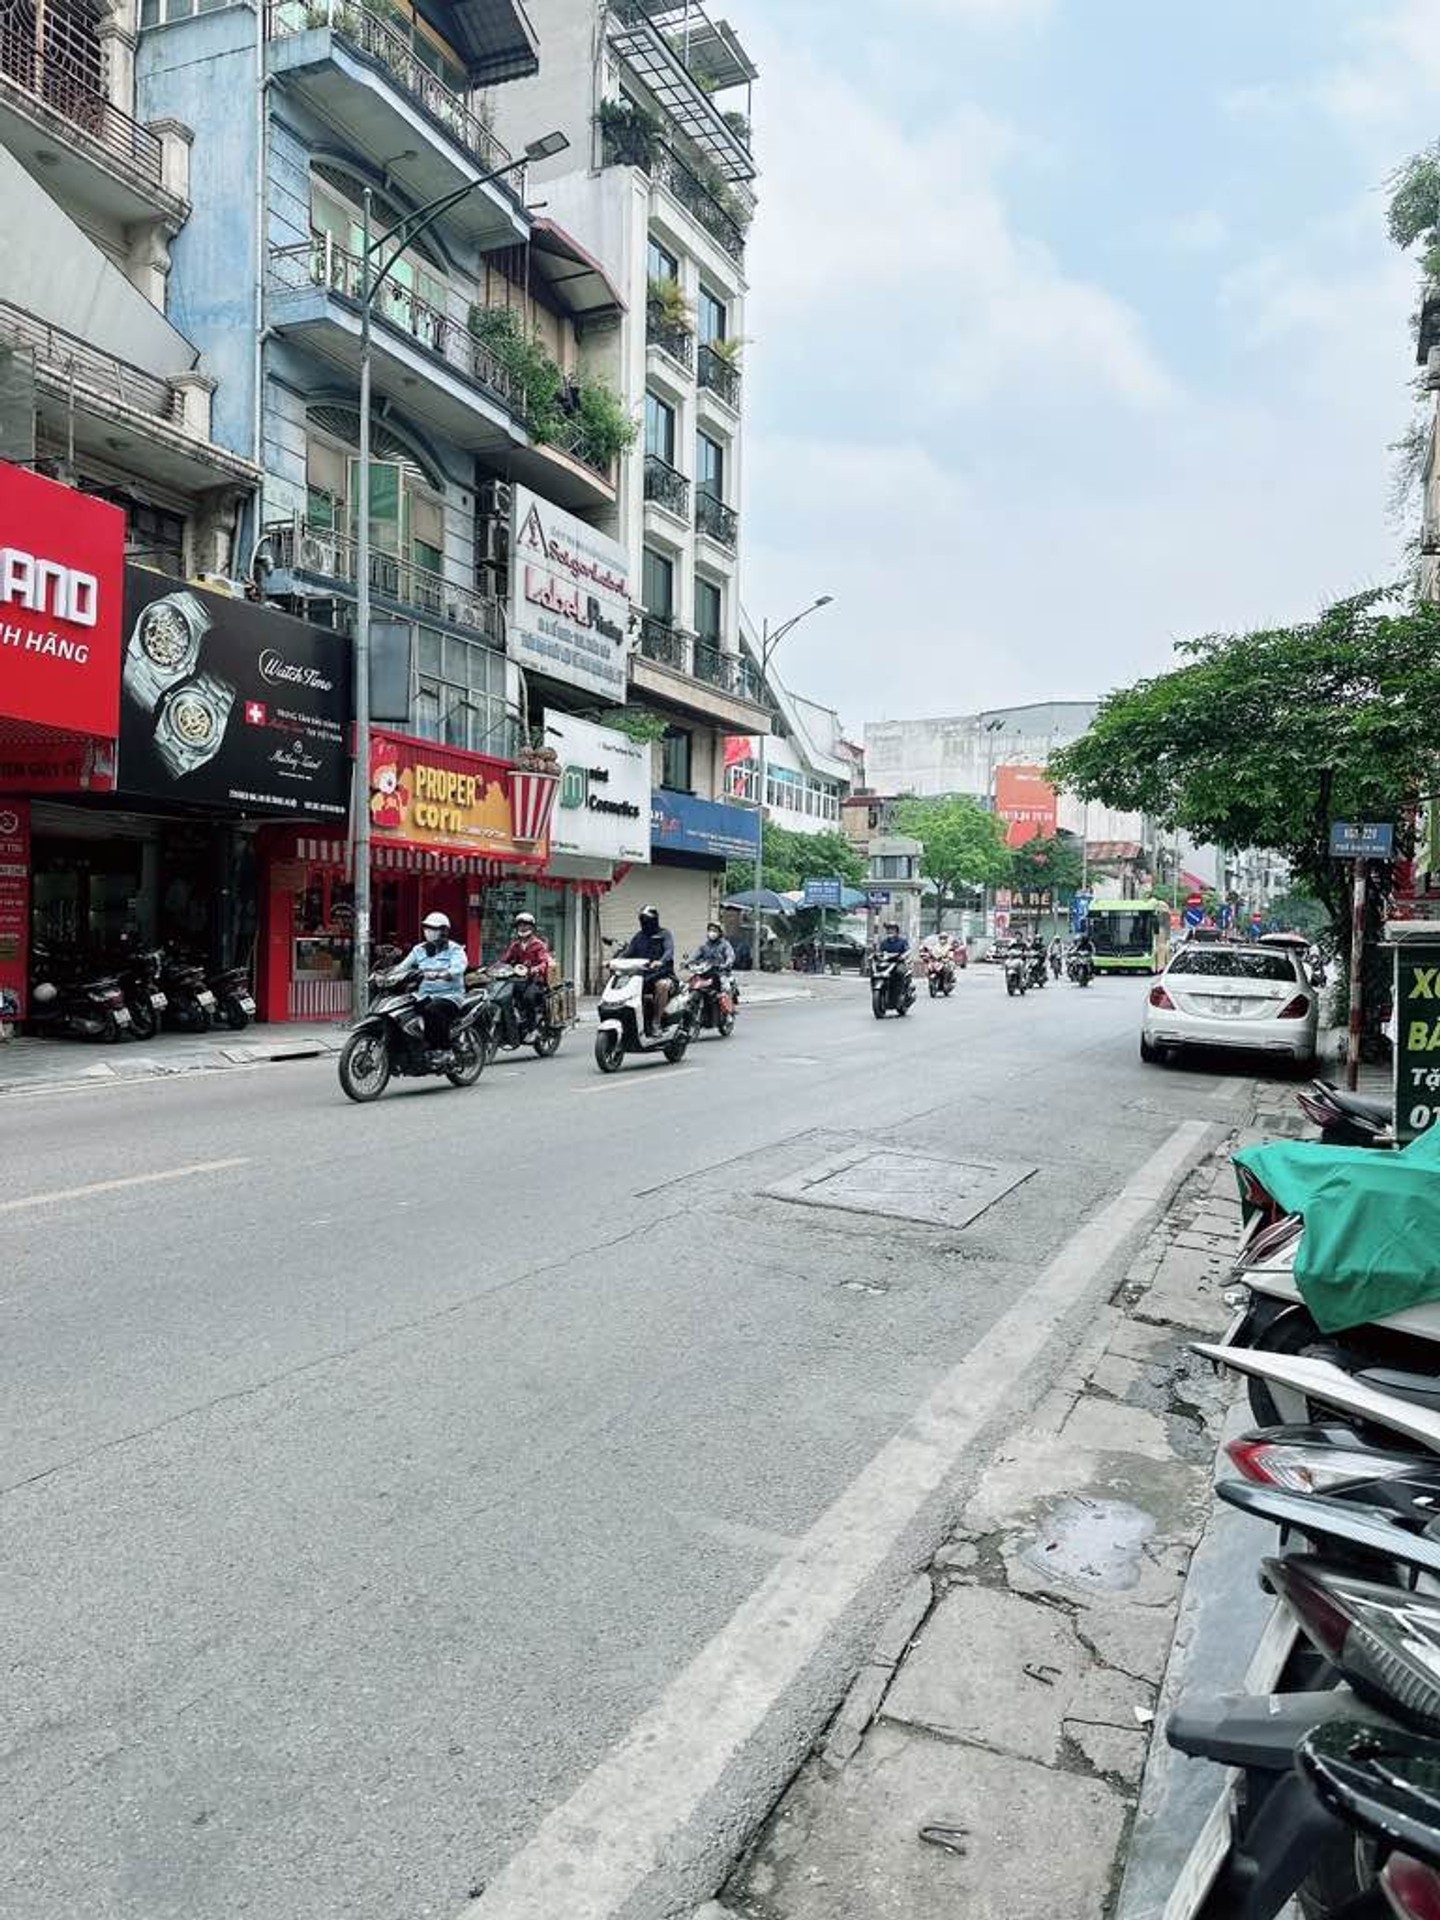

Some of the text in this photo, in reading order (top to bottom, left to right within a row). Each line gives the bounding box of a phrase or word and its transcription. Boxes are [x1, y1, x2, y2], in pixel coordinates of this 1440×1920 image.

[25, 631, 89, 664] HÃNG
[264, 657, 333, 691] Watch Time
[415, 764, 477, 806] PROPER
[415, 803, 463, 832] corn
[588, 793, 640, 819] Cosmetics
[1409, 1104, 1440, 1129] 0
